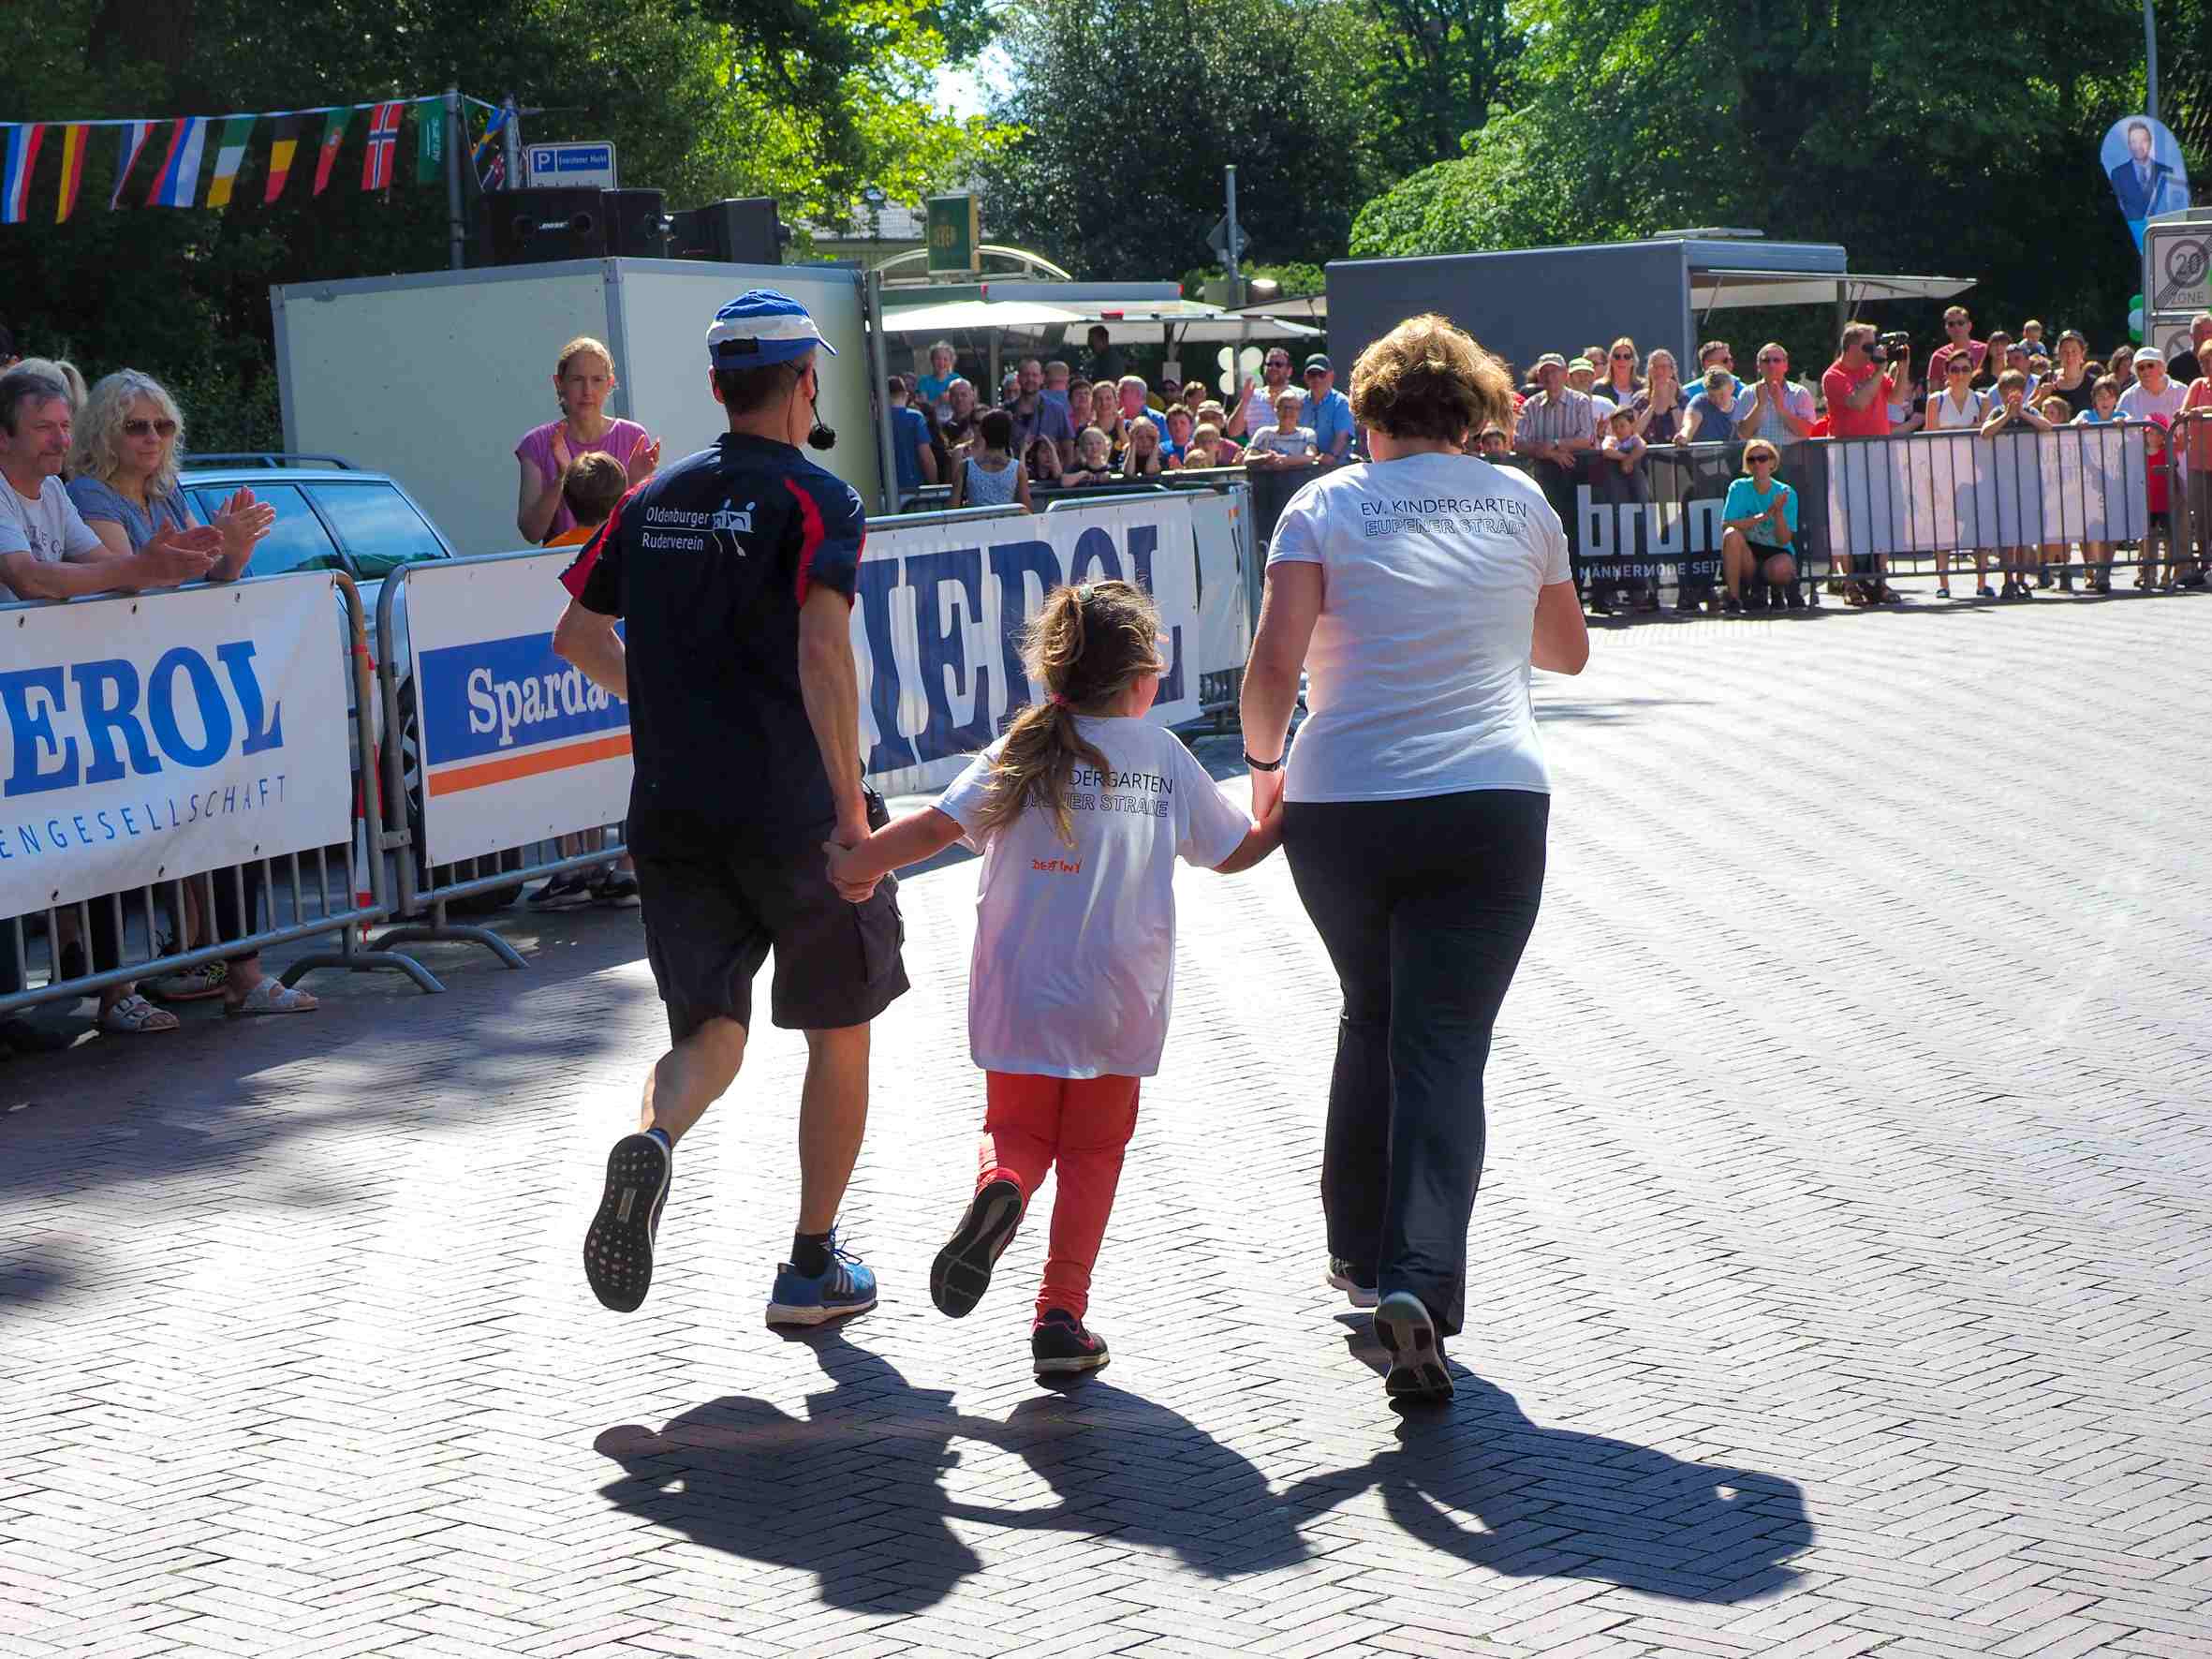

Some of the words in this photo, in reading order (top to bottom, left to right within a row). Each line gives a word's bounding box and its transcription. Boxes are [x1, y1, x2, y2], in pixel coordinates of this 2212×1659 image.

[538, 153, 551, 170] P
[646, 506, 710, 527] Oldenburger
[1361, 501, 1387, 515] EV.
[1393, 497, 1526, 517] KINDERGARTEN
[1364, 518, 1455, 537] EUPENER
[641, 532, 704, 551] Ruderverein
[1579, 563, 1687, 579] MÄNNERMODE
